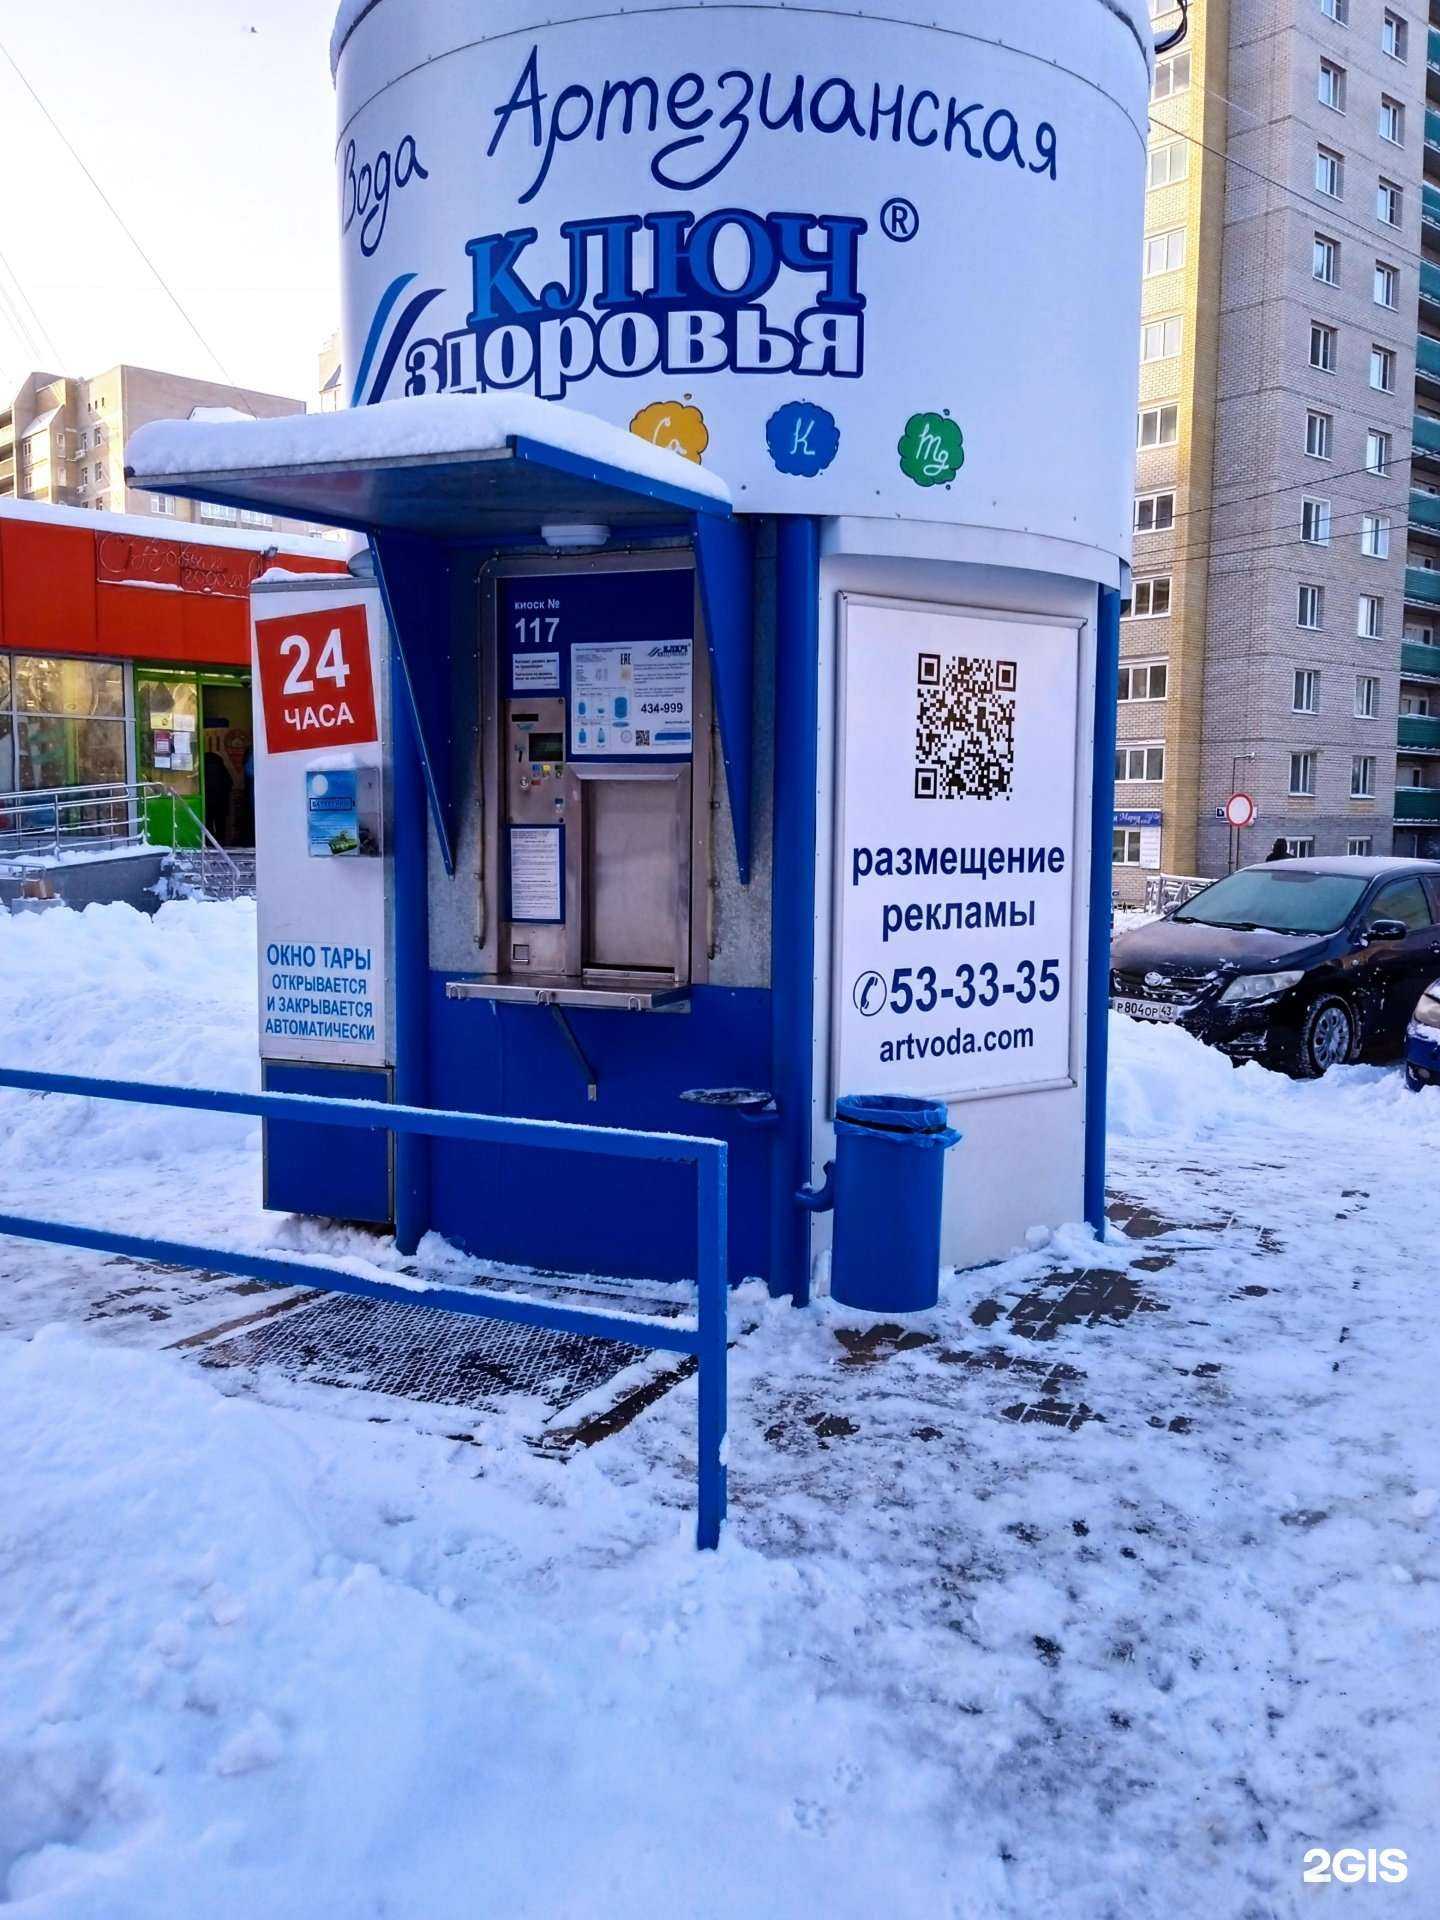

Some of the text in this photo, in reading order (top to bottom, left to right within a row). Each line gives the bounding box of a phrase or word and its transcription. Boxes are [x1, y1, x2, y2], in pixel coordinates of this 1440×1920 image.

[342, 44, 1058, 257] Вода Артезианская
[465, 208, 868, 326] КЛЮЧ
[404, 303, 865, 401] здоровья
[547, 598, 560, 609] №
[515, 617, 560, 643] 117
[279, 628, 351, 696] 24
[283, 702, 355, 731] ЧАСА
[640, 702, 684, 714] 434-999
[852, 846, 1066, 886] размещение
[882, 900, 1036, 943] рекламы
[266, 943, 371, 970] ОКНО ТАРЫ
[272, 973, 367, 995] ОТКРЫВАЕТСЯ
[889, 958, 1061, 1014] 53-33-35
[266, 996, 373, 1018] И ЗАКРЫВАЕТСЯ
[265, 1018, 375, 1041] АВТОМАТИЧЕСКИ
[879, 1026, 1035, 1063] artvoda.com
